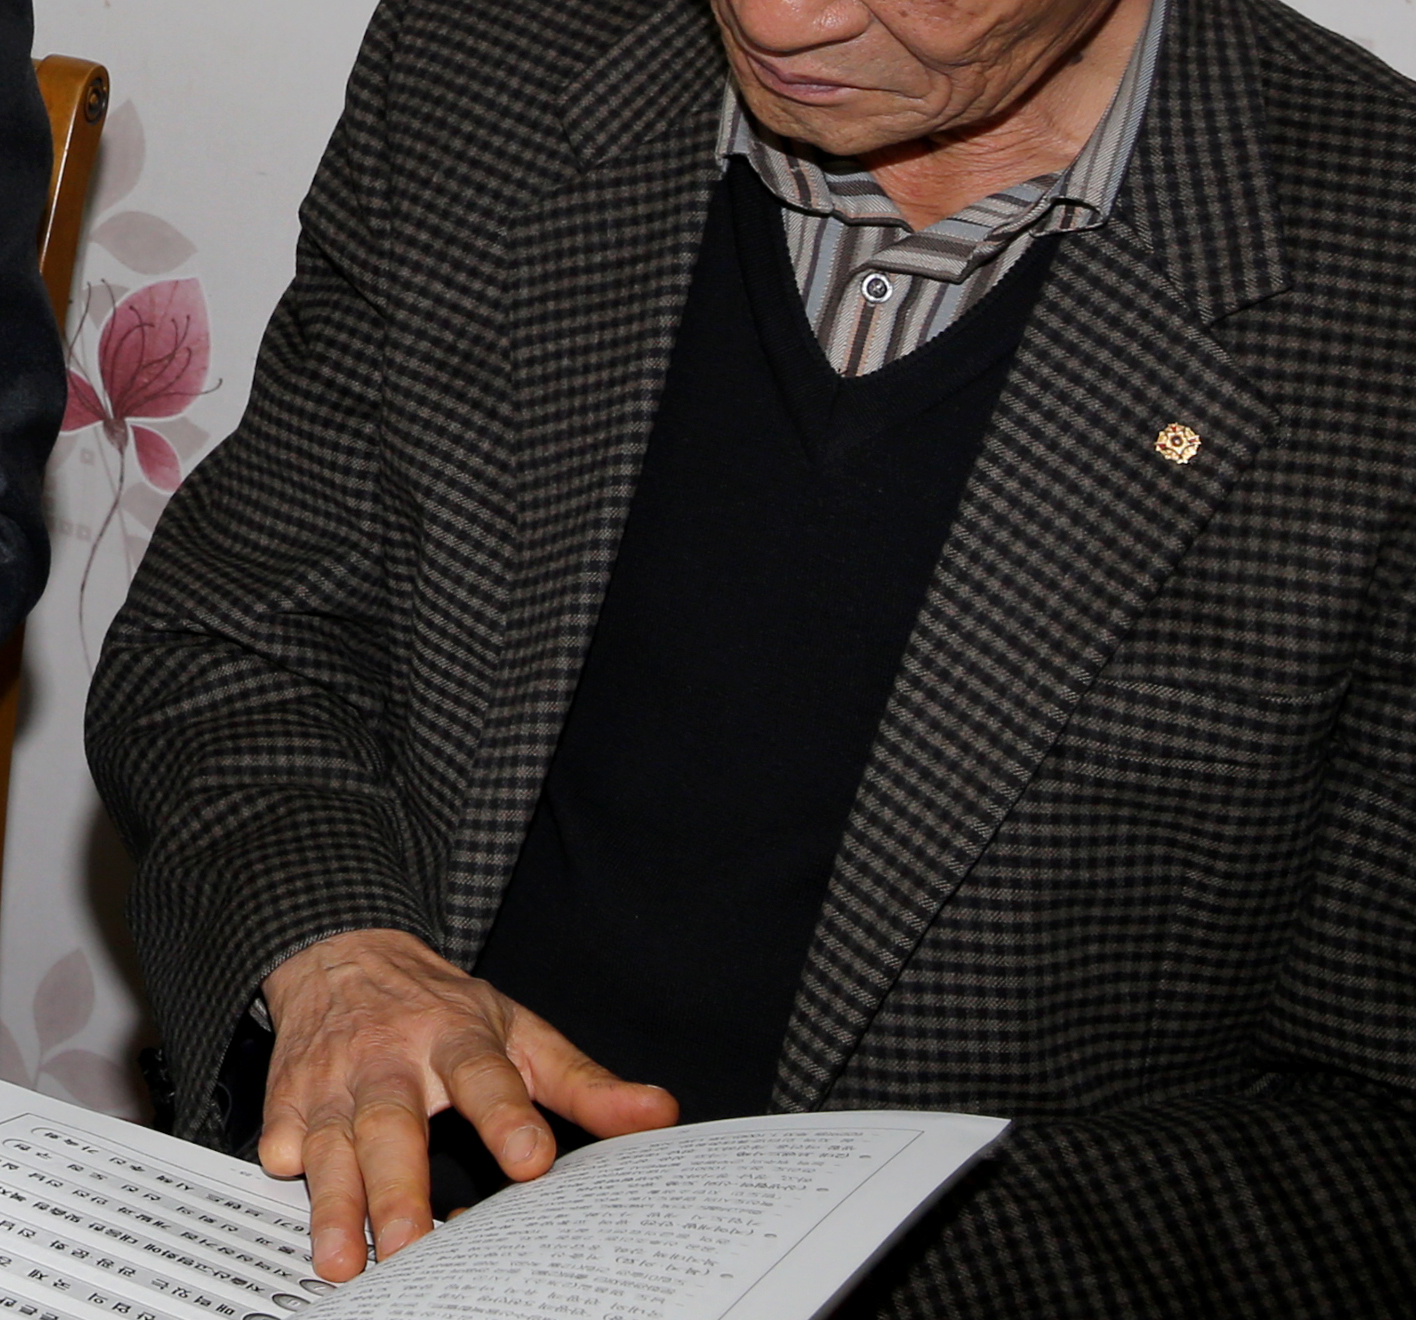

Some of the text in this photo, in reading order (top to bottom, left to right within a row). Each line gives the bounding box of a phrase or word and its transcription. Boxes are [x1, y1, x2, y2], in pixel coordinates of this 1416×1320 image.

[42, 1131, 99, 1155] 가속화
[108, 1156, 146, 1173] 추진
[13, 1142, 238, 1233] 신뢰의 선진 도정 구현
[28, 1171, 64, 1189] 전남
[155, 1174, 193, 1192] 시책
[72, 1188, 108, 1206] 안전
[33, 1201, 83, 1223] 맞춤형
[116, 1206, 172, 1230] 개발과
[87, 1222, 139, 1245] 대응한
[180, 1231, 292, 1279] 지역성장거점
[28, 1268, 71, 1292] 국제
[151, 1278, 235, 1316] 매력있는
